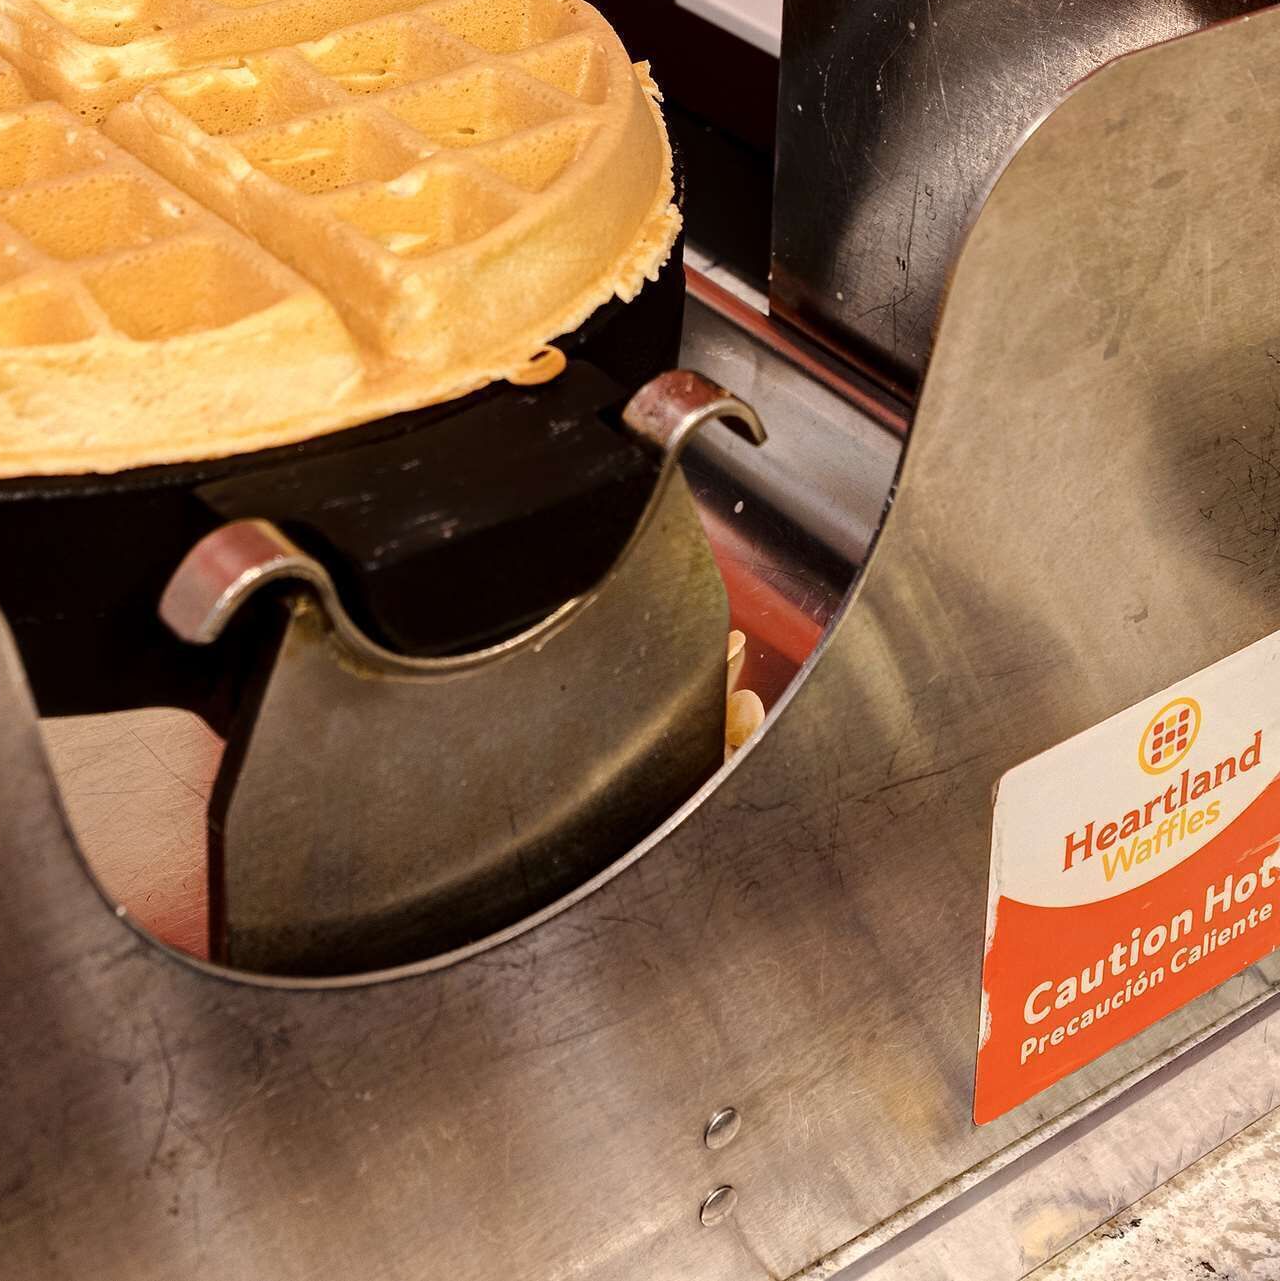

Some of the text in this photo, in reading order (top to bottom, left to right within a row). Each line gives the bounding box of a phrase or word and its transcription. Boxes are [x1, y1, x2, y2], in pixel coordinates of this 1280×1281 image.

[1061, 730, 1264, 872] Heartland
[1101, 798, 1221, 883] Waffles
[1020, 901, 1274, 1066] Precaución Caliente
[1022, 856, 1278, 1026] Caution Hot
